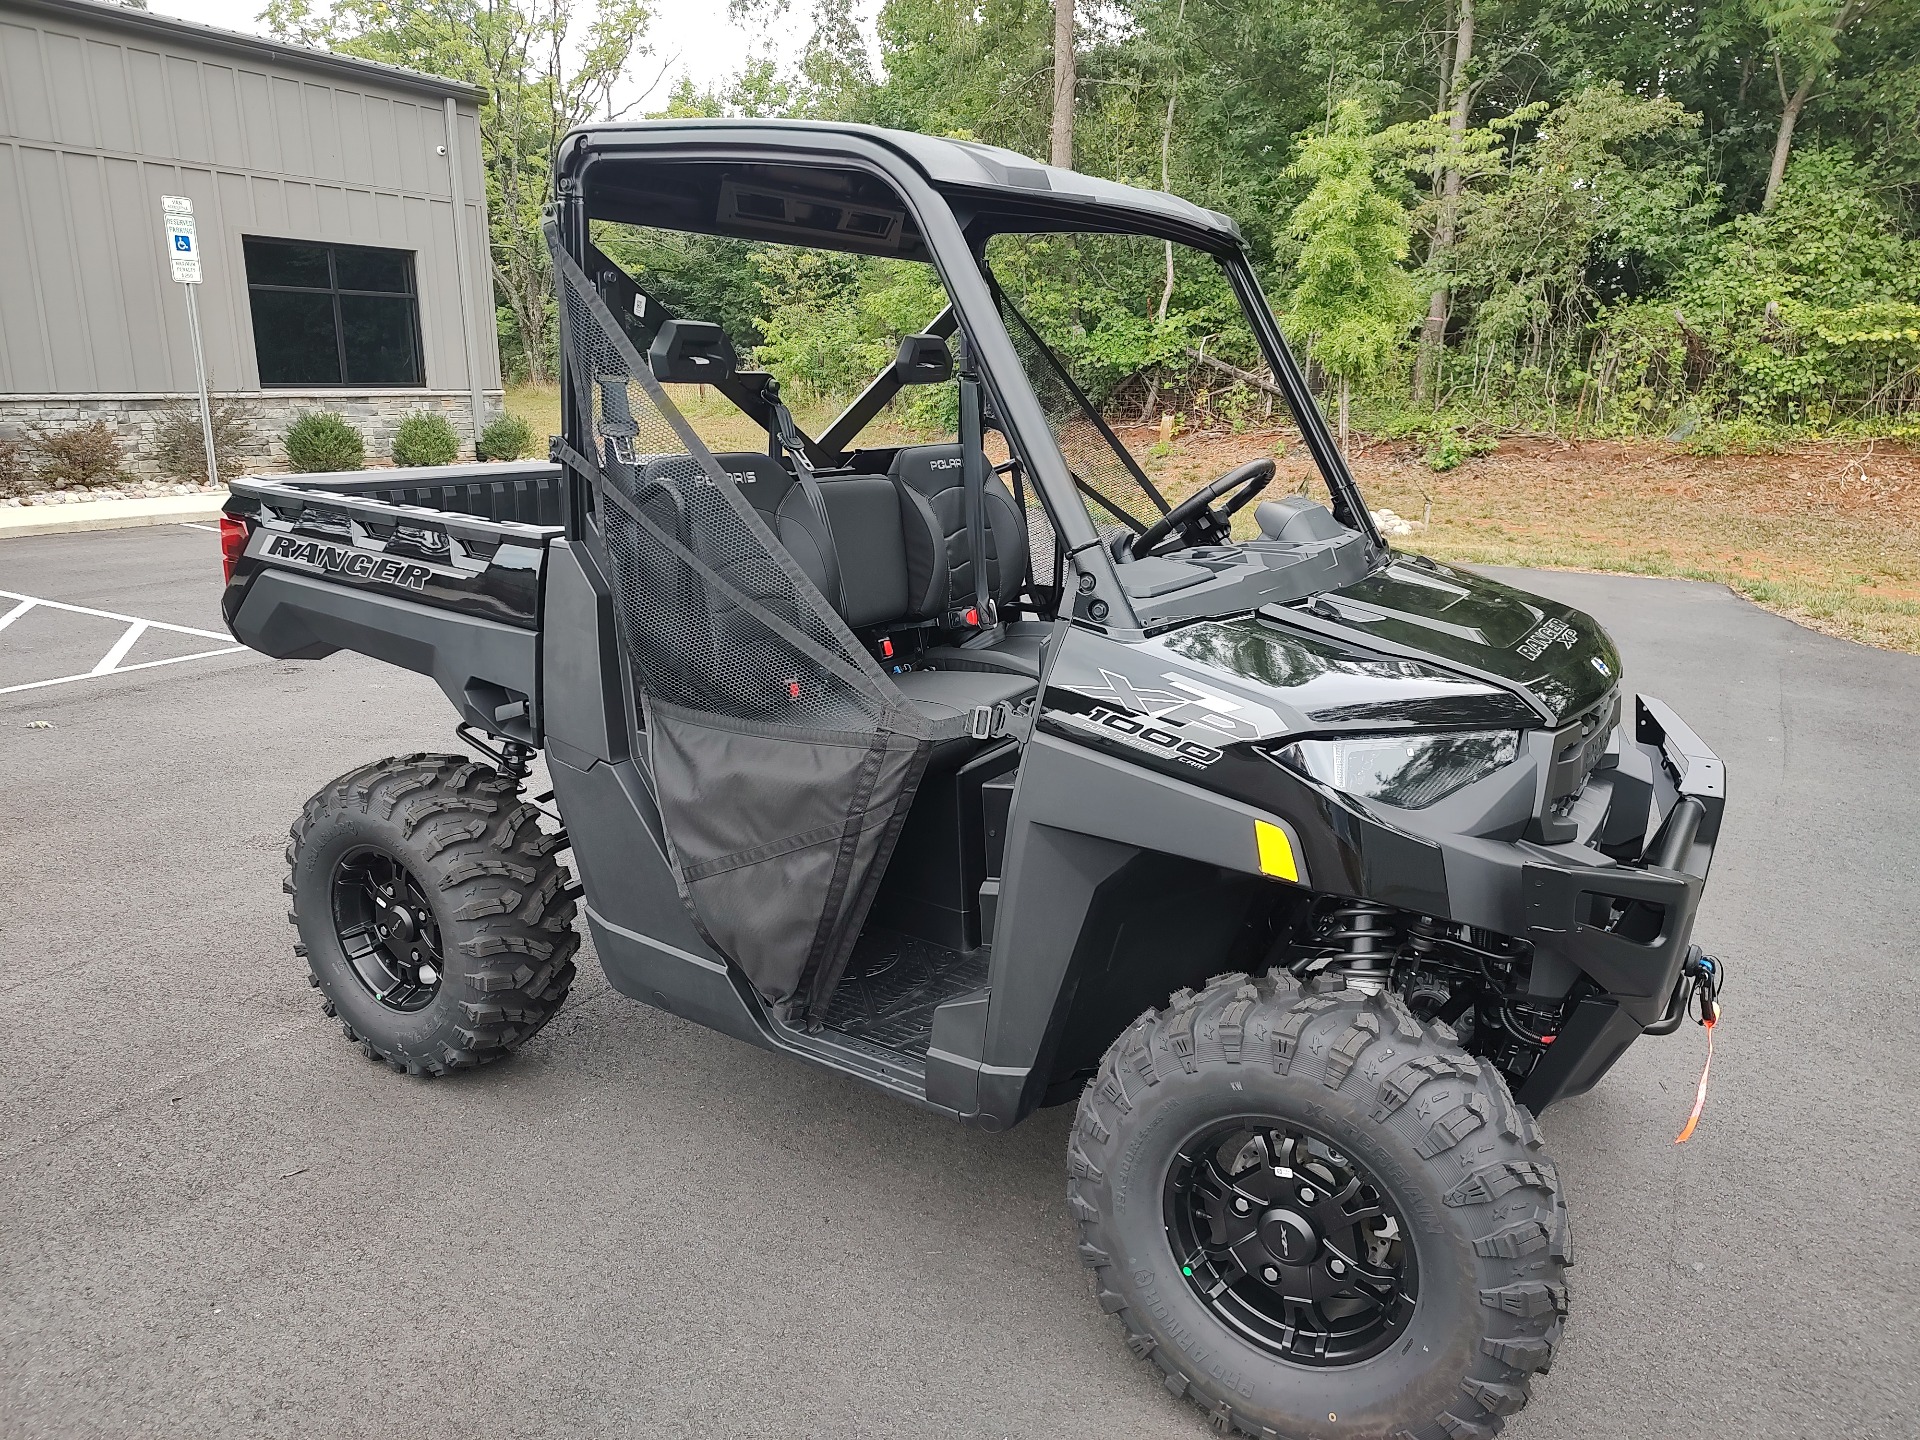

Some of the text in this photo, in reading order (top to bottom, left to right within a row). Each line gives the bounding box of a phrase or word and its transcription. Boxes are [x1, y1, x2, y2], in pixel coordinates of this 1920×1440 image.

[167, 218, 193, 227] RESERVED
[169, 226, 193, 234] PARKING
[929, 458, 964, 471] POLAR
[267, 534, 433, 591] RANGER
[1515, 617, 1570, 662] RANGER
[1556, 628, 1579, 650] XP
[1058, 667, 1262, 740] XP
[1087, 705, 1225, 766] 1000
[1178, 755, 1208, 770] CAM
[1303, 1099, 1446, 1235] X-TERRAIN
[1143, 1287, 1256, 1399] PRO ARMOR
